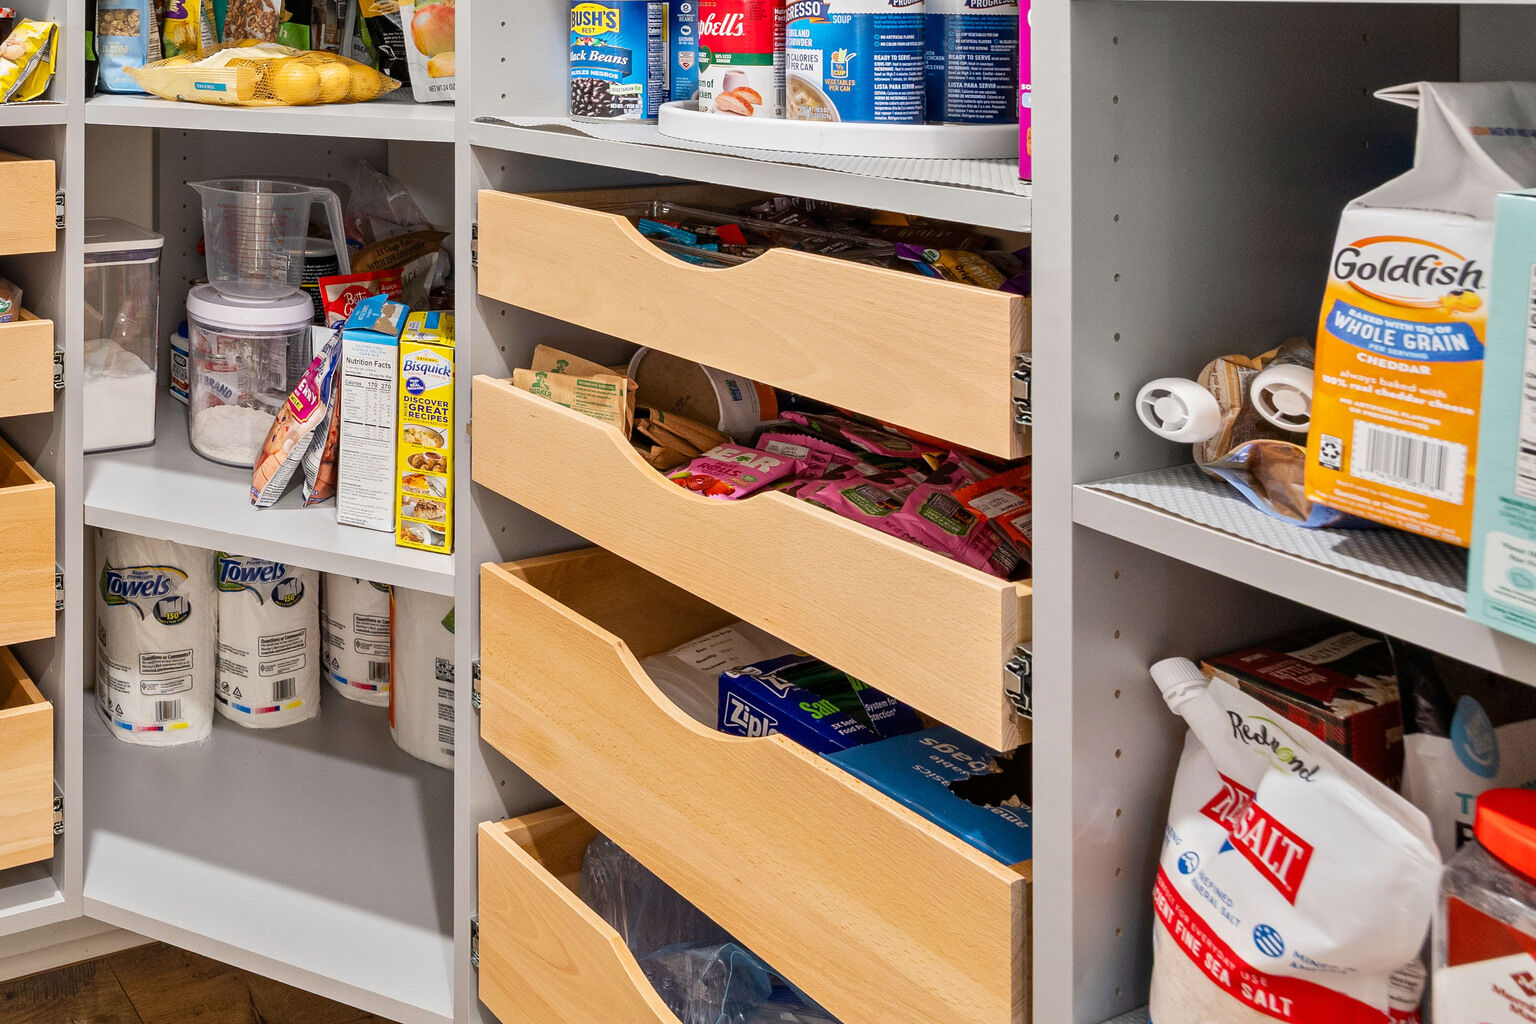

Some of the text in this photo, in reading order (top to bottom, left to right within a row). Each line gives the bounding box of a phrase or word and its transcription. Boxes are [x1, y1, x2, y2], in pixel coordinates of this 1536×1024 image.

[570, 10, 617, 29] BUSH'S
[832, 15, 852, 24] SOUP
[588, 50, 629, 65] Beans
[791, 54, 818, 63] CALORIES
[791, 62, 814, 71] PER CAN
[825, 79, 856, 87] VEGETABLES
[1334, 247, 1486, 291] Goldfish
[1348, 308, 1414, 332] BAKED WITH
[1334, 310, 1470, 352] WHOLE GRAIN
[1367, 343, 1429, 360] PER SERVING
[345, 356, 392, 370] Nutrition Facts
[403, 360, 452, 377] Bisquick
[1356, 352, 1432, 376] CHEDDAR
[380, 382, 392, 390] 270
[1339, 370, 1448, 399] always baked with
[403, 395, 449, 408] DISCOVER
[1321, 374, 1475, 416] 100% real cheddar cheese
[408, 403, 449, 416] GREAT
[408, 411, 449, 423] RECIPES
[219, 558, 286, 584] Towels
[106, 571, 170, 597] Towels
[166, 612, 179, 621] 150
[1220, 907, 1242, 928] SALT
[1175, 922, 1295, 1018] FINE SEA SALT
